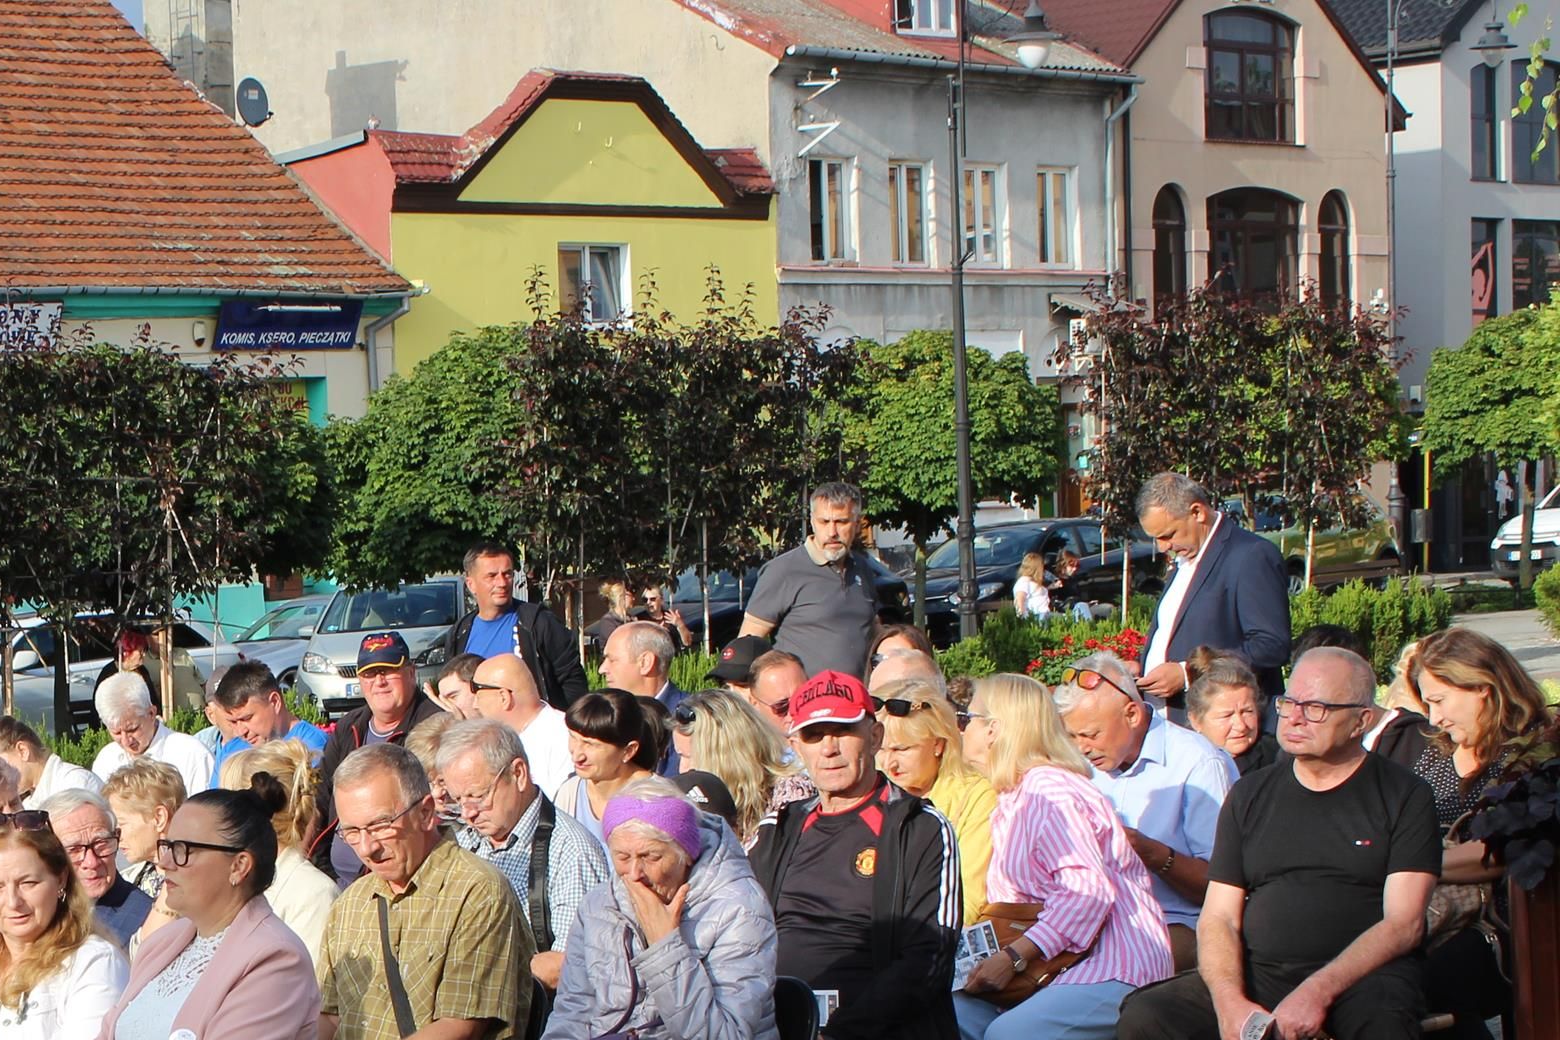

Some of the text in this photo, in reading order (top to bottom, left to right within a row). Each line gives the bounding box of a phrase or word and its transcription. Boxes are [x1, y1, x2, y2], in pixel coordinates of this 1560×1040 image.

[220, 331, 352, 347] KOMIS, KSERO, PIECZĄTKI
